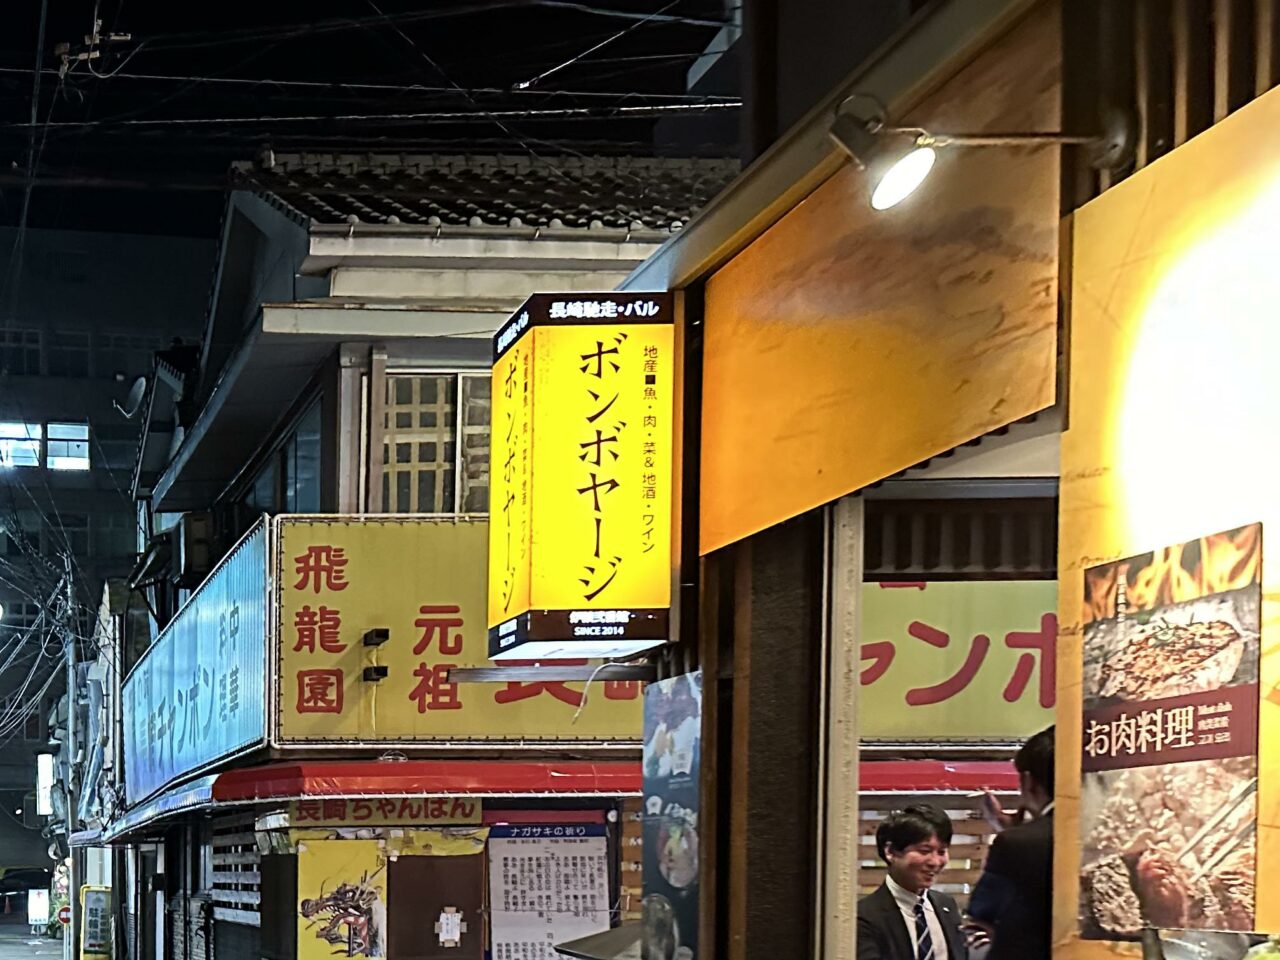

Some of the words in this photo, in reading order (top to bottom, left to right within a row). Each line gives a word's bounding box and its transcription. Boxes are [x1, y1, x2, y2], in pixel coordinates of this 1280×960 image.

[576, 332, 629, 602] ボンボヤージ
[293, 544, 350, 714] 飛龍園
[407, 604, 465, 714] 元祖
[574, 626, 602, 636] SINCE
[1085, 706, 1196, 757] お肉料理
